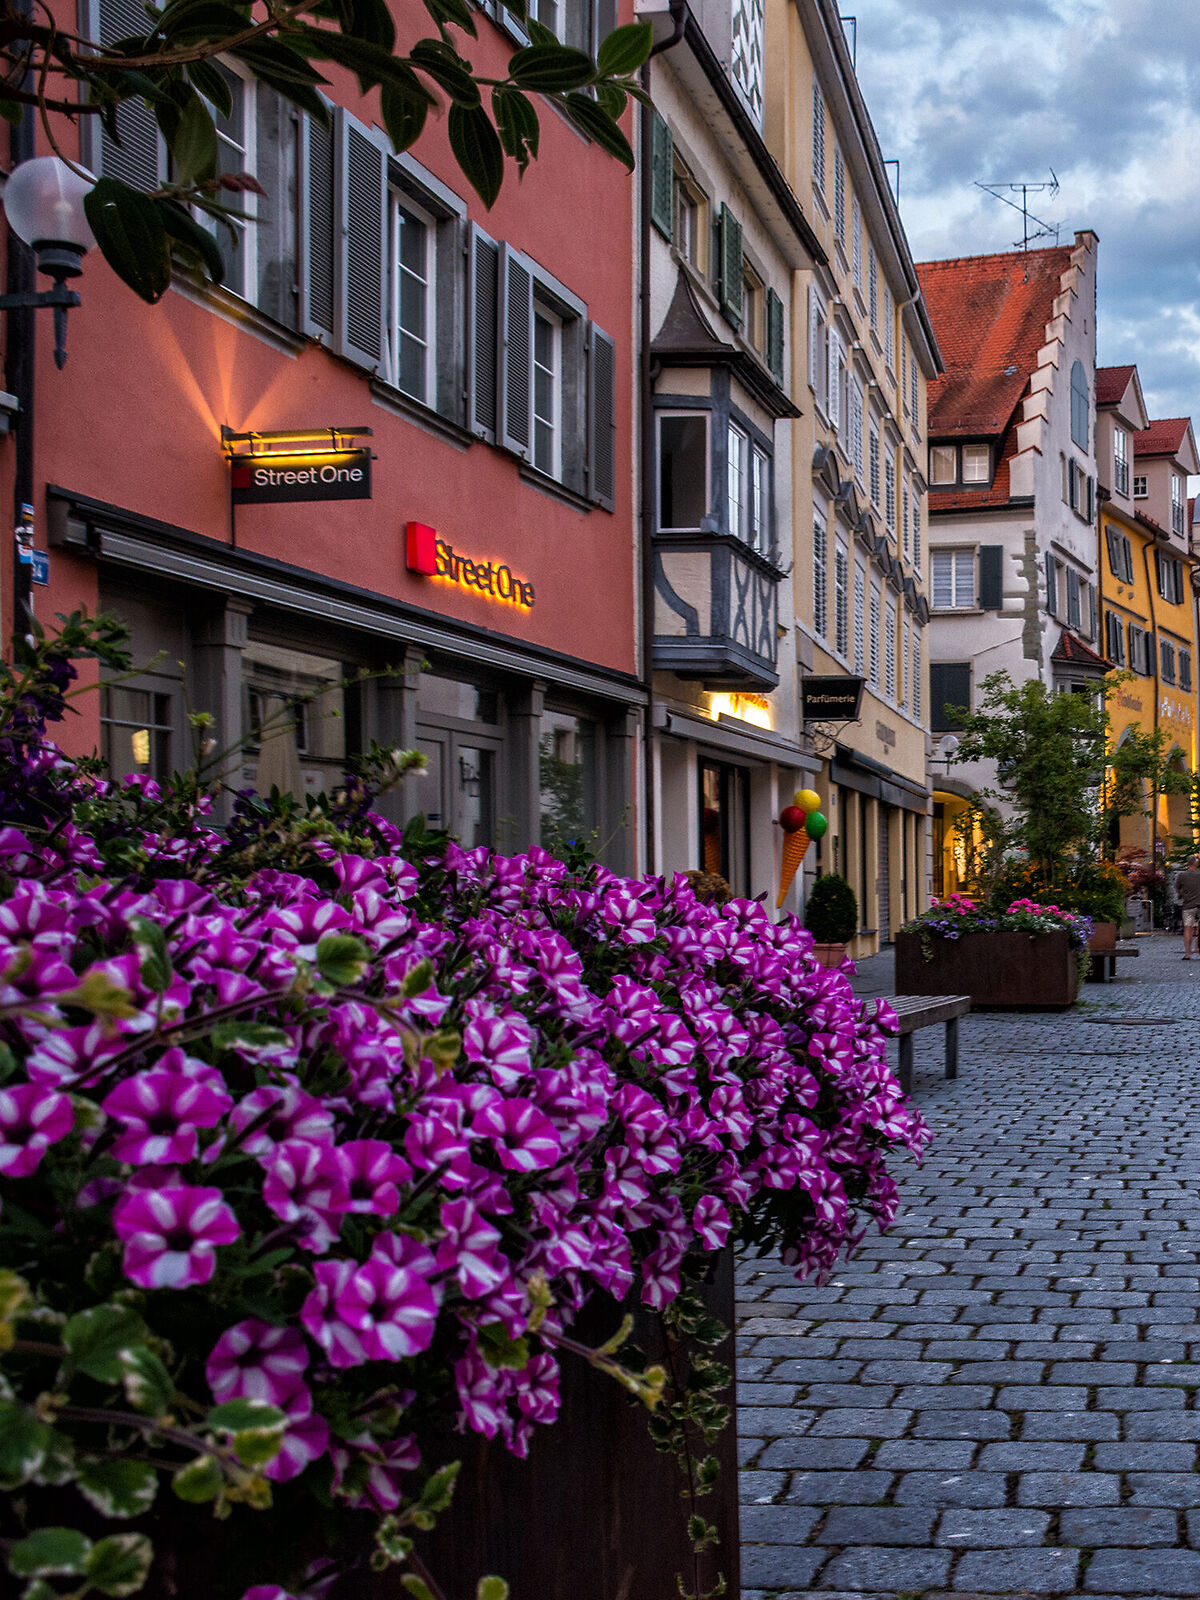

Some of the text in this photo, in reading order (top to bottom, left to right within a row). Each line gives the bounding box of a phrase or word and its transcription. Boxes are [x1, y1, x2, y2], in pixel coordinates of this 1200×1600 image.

[254, 465, 363, 486] Street One
[435, 539, 535, 607] Street One
[806, 694, 856, 704] Parfümerie
